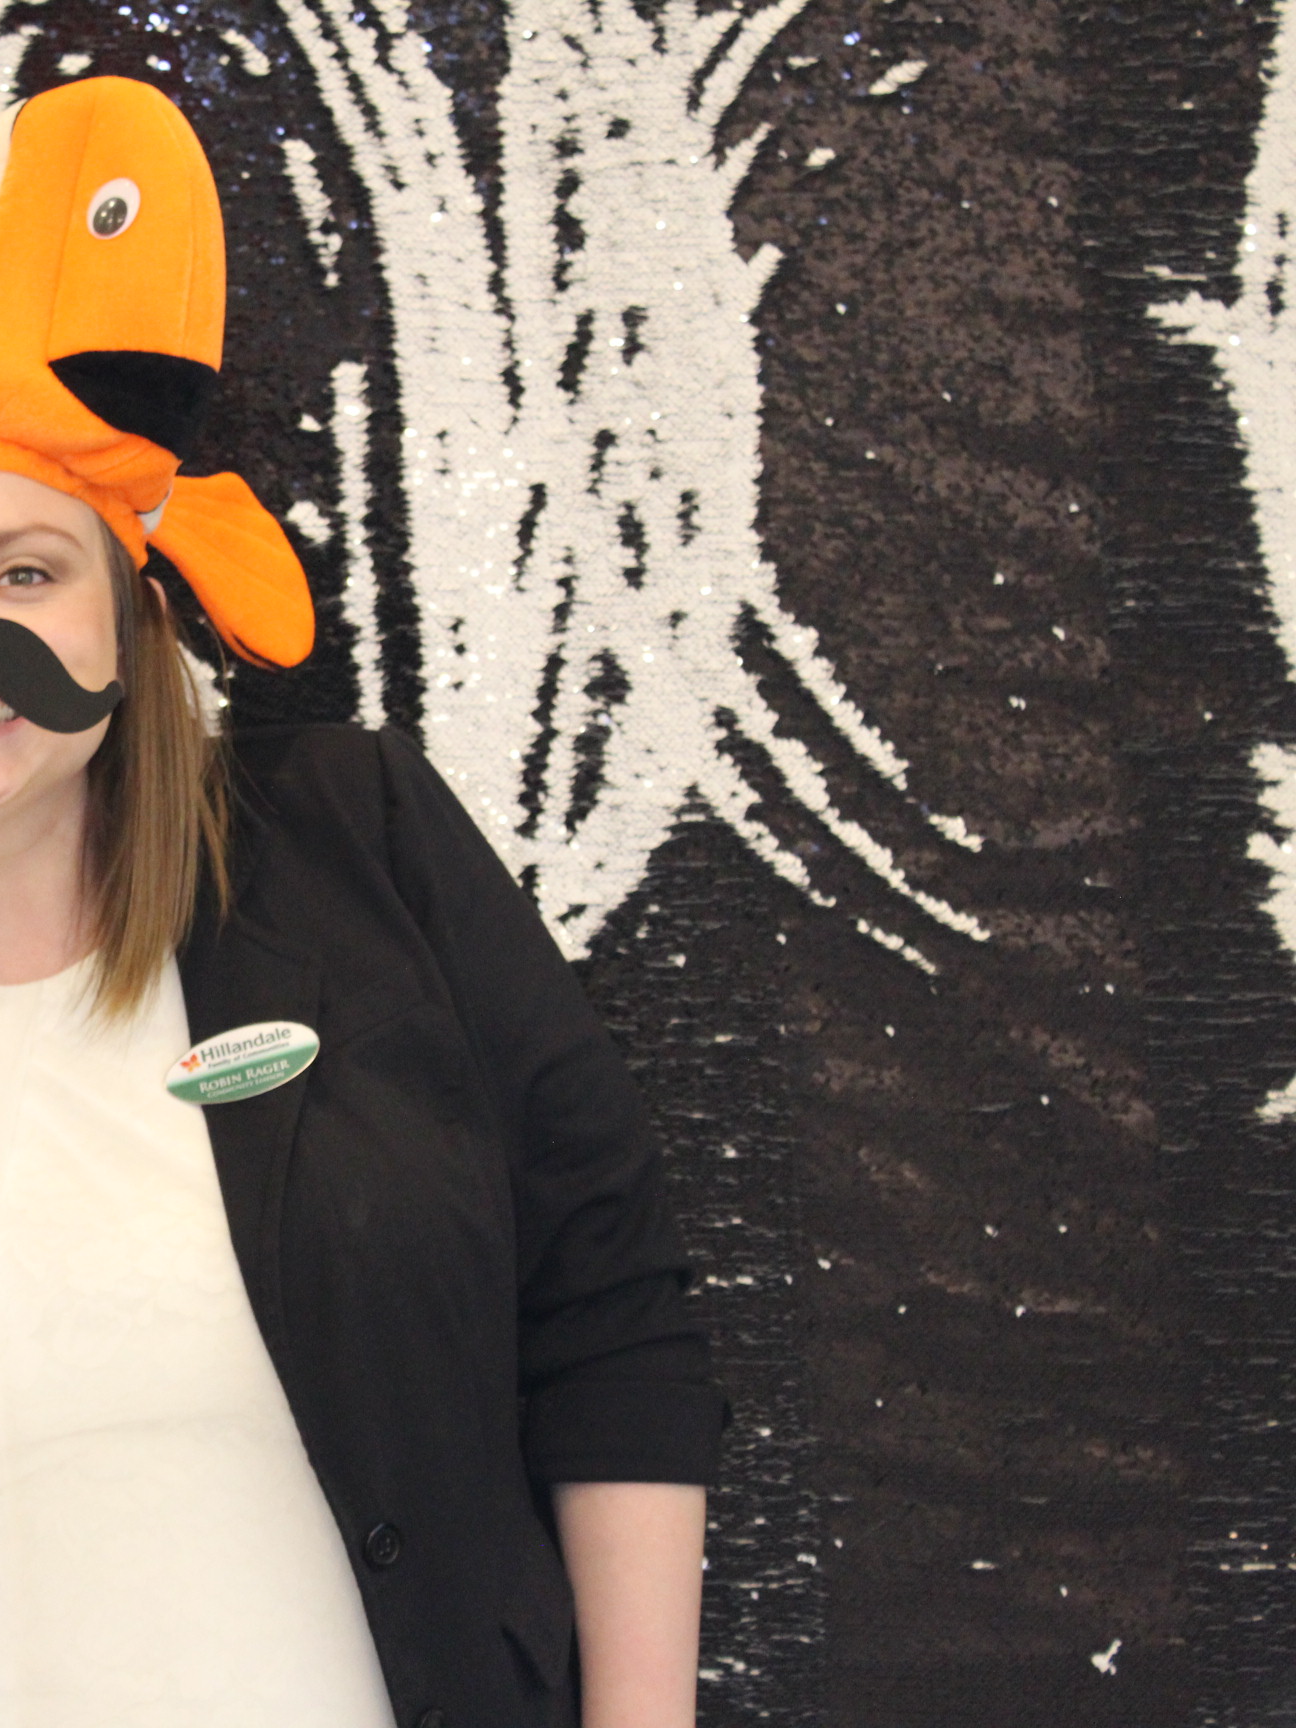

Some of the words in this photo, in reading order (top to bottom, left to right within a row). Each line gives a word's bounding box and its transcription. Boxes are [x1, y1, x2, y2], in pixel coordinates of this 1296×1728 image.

[200, 1027, 292, 1062] Hillandale
[199, 1073, 242, 1093] ROBIN
[245, 1060, 290, 1080] RAGER
